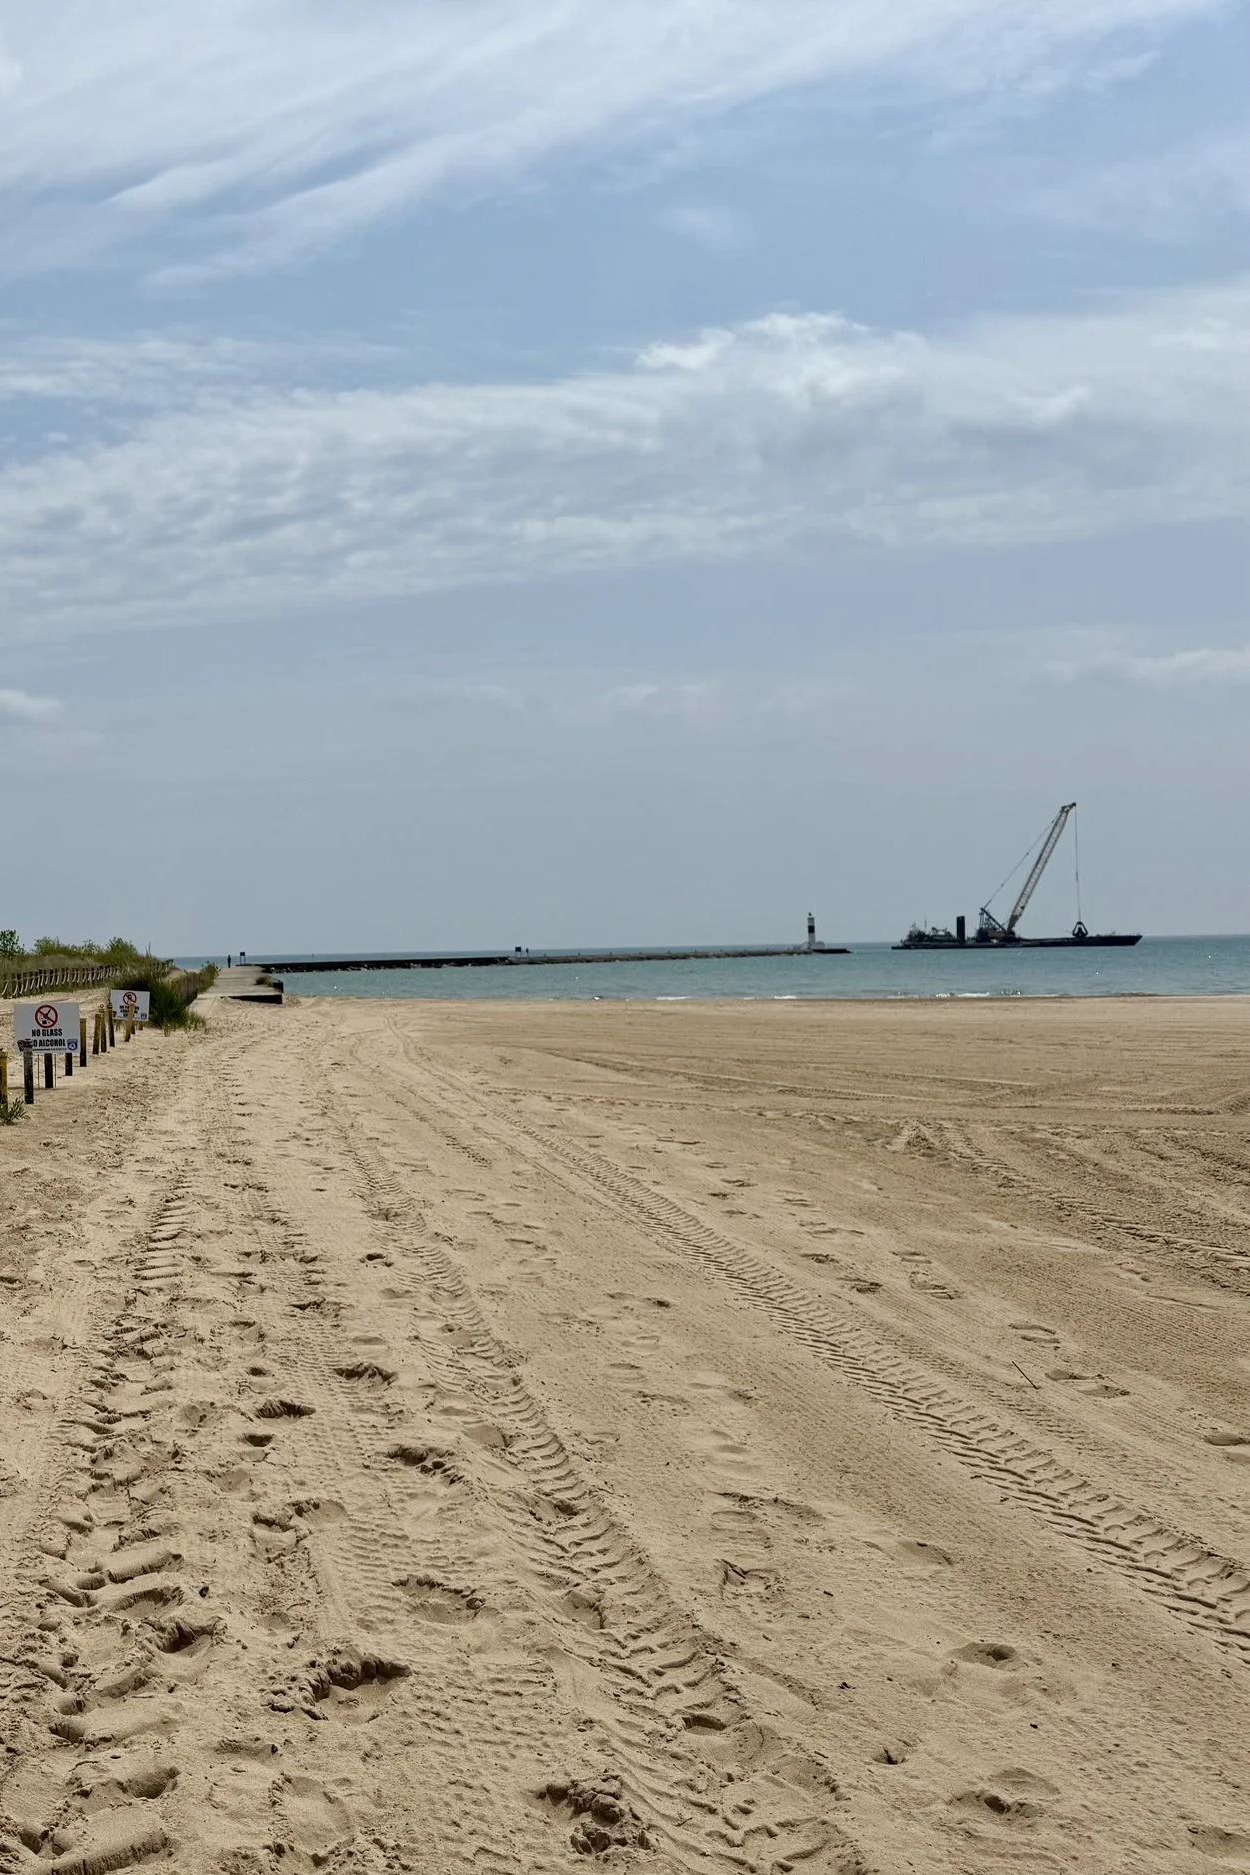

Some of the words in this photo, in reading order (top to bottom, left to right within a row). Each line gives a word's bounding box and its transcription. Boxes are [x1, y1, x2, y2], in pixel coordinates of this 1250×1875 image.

[32, 1029, 41, 1037] NO
[42, 1028, 63, 1037] GLASS
[39, 1039, 66, 1047] ALCOHOL
